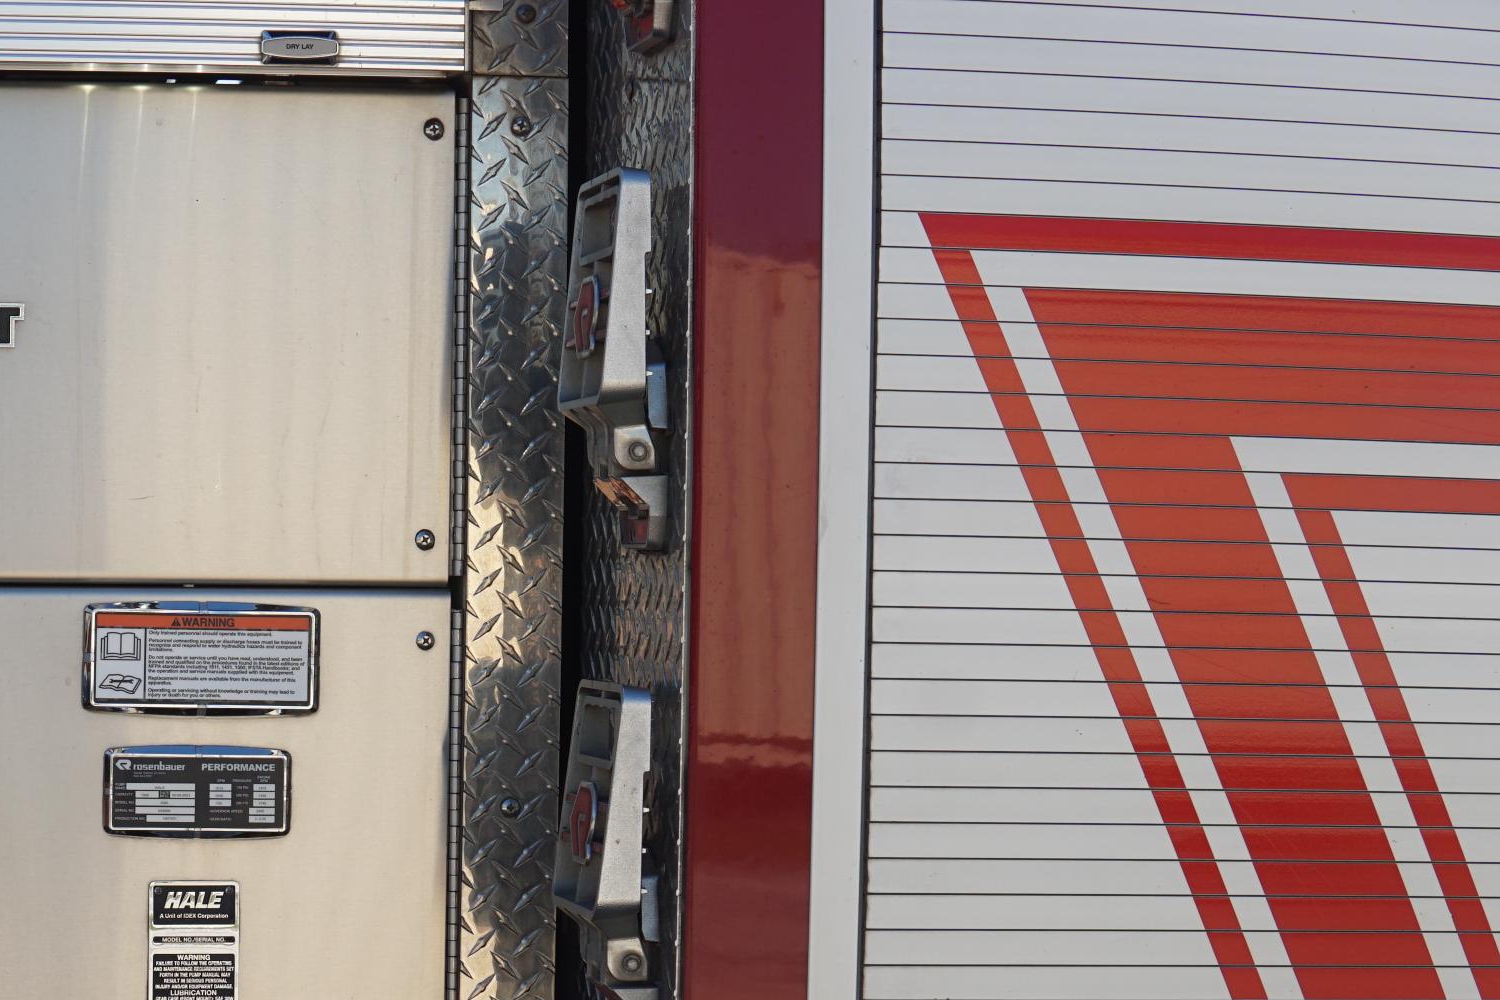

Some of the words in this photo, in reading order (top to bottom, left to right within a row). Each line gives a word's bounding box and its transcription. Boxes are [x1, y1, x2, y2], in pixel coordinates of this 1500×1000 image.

[182, 618, 234, 627] WARNING
[133, 761, 186, 771] rosenbauer
[202, 763, 276, 772] PERFORMANCE
[164, 892, 224, 908] HALE
